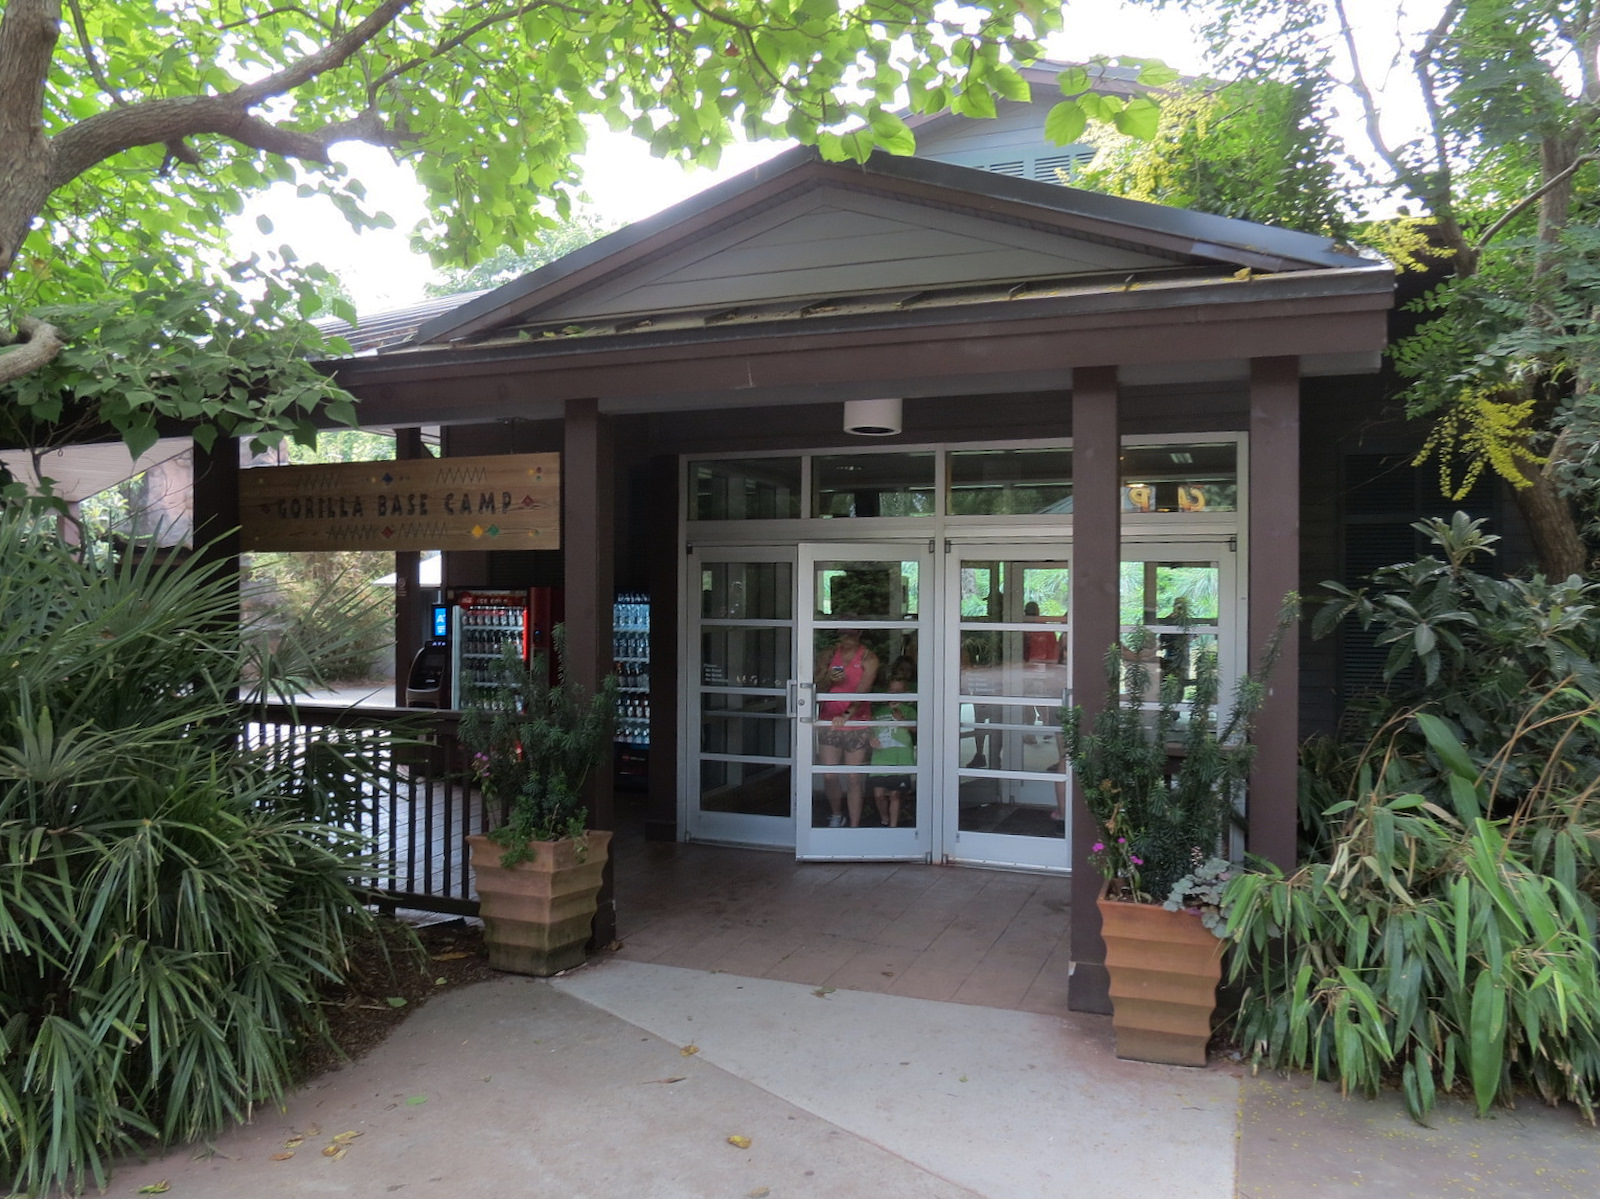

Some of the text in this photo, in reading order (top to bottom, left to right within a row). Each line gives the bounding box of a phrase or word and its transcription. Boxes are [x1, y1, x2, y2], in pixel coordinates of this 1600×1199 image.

[277, 491, 513, 519] GORILLA BASE CAMP
